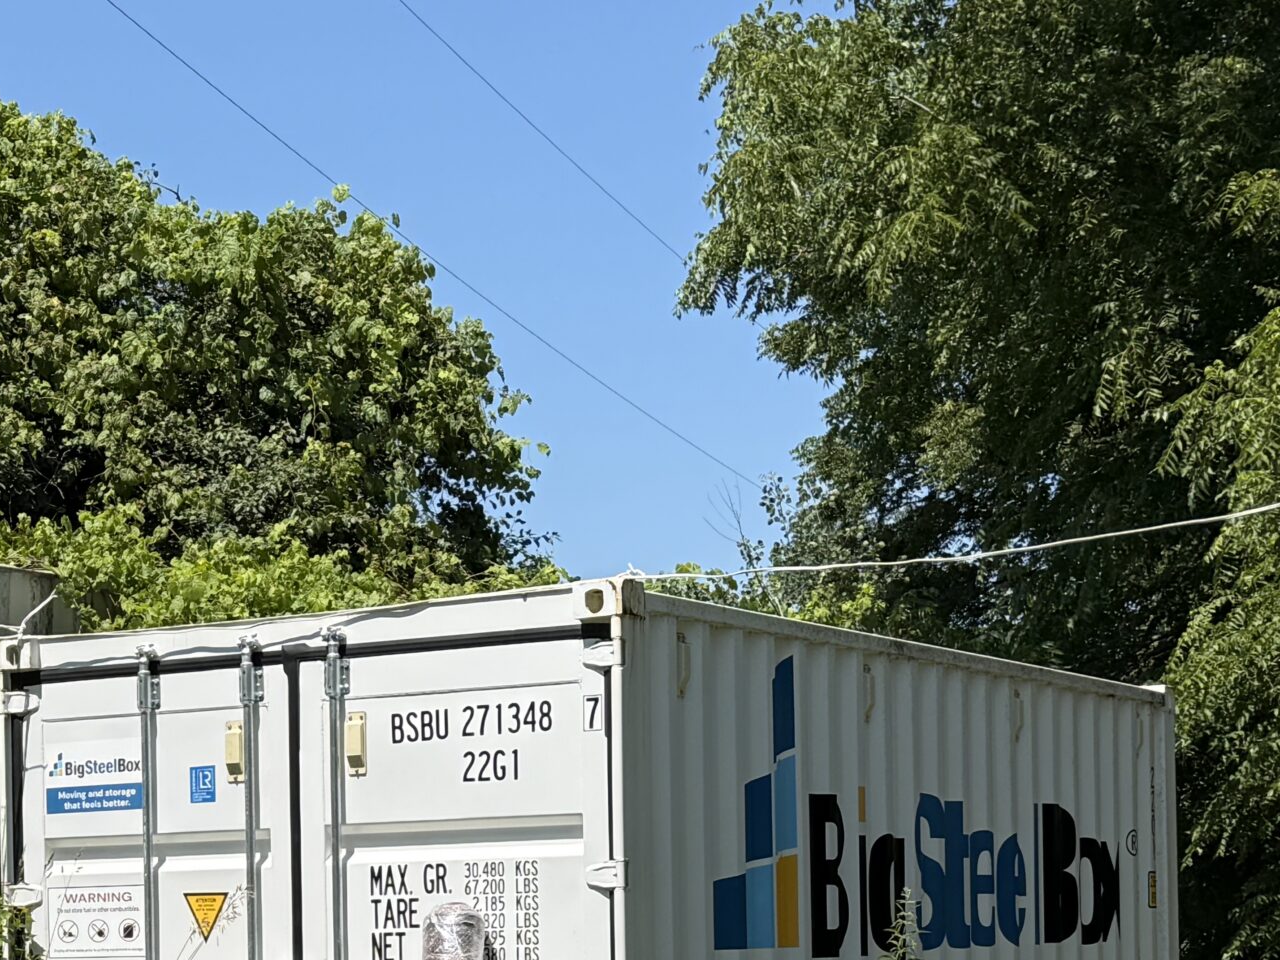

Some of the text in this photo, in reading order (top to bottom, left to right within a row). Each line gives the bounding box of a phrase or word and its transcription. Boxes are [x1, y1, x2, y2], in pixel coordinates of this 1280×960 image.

[391, 697, 599, 744] BSBU 271348 7
[65, 758, 140, 778] BigSteelBox
[462, 749, 518, 782] 22G1
[58, 788, 136, 800] Moving and storage
[64, 799, 131, 810] that feels better.
[370, 860, 538, 896] MAX. GR. 30.480 KGS
[464, 877, 539, 896] 67.200 LBS
[64, 892, 132, 904] WARNING
[370, 895, 539, 929] TARE 2.185 KGS
[516, 912, 539, 929] LBS
[516, 929, 540, 946] KGS
